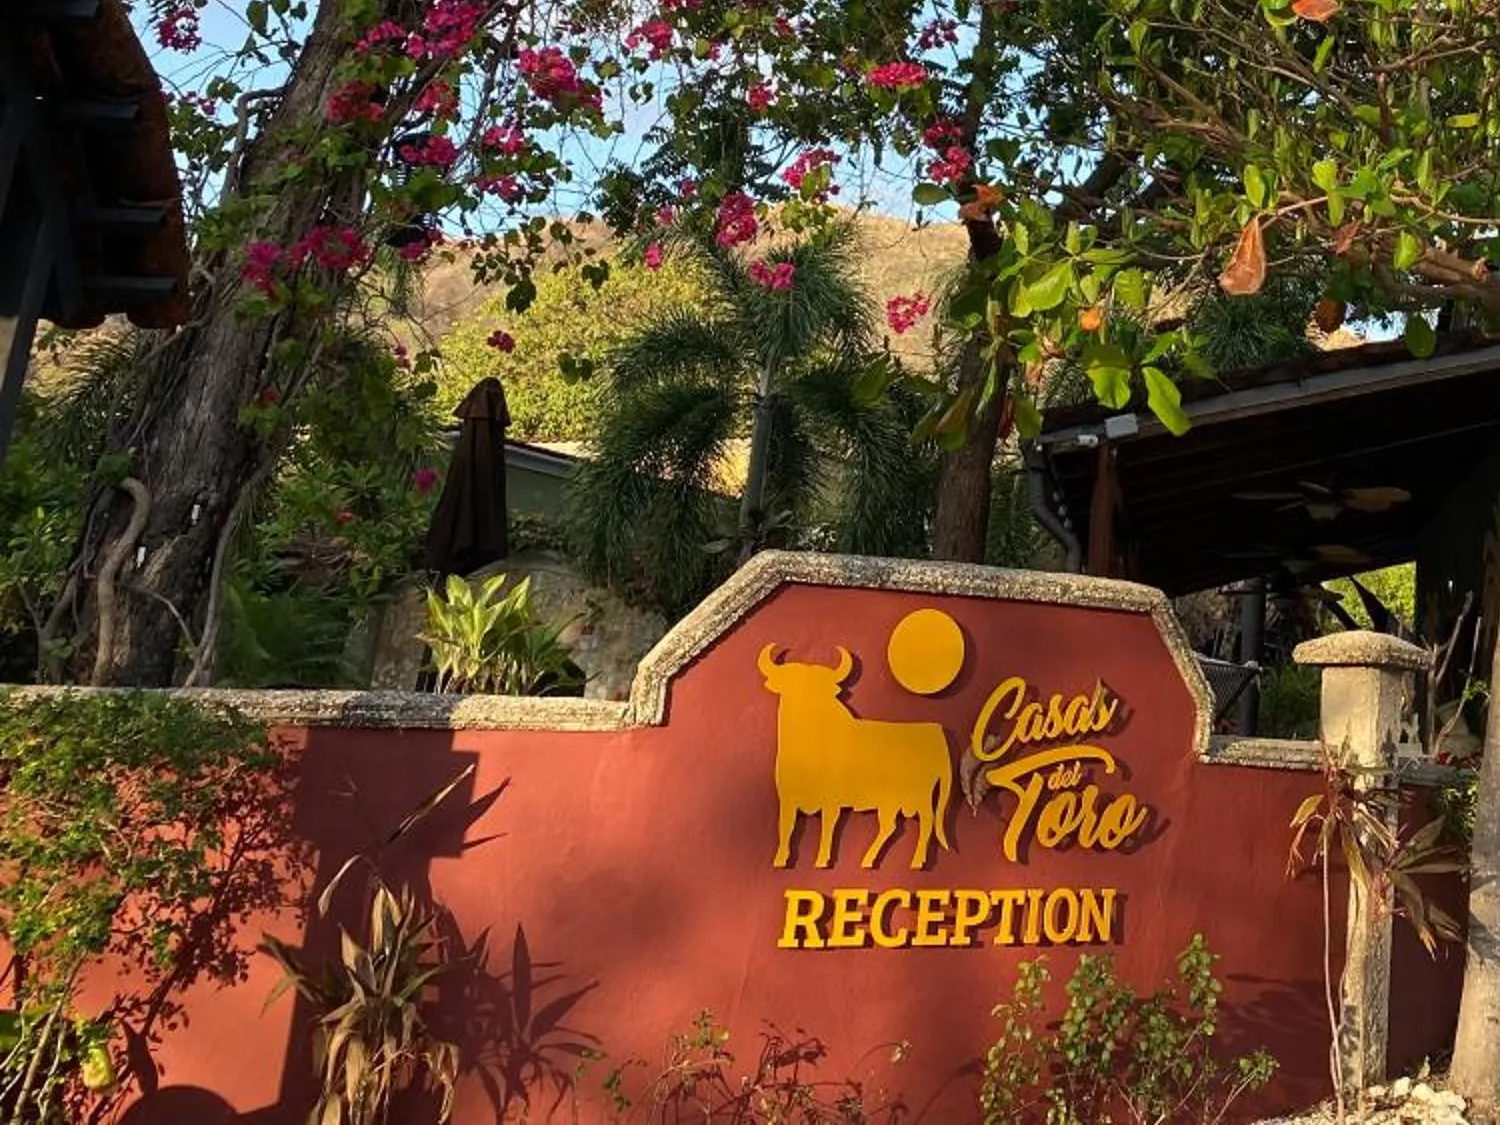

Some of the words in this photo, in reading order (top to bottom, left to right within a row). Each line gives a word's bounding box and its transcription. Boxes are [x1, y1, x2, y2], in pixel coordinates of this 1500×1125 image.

[972, 677, 1119, 761] Casas
[986, 744, 1148, 862] Toro
[1047, 761, 1082, 790] del
[777, 888, 1117, 948] RECEPTION
